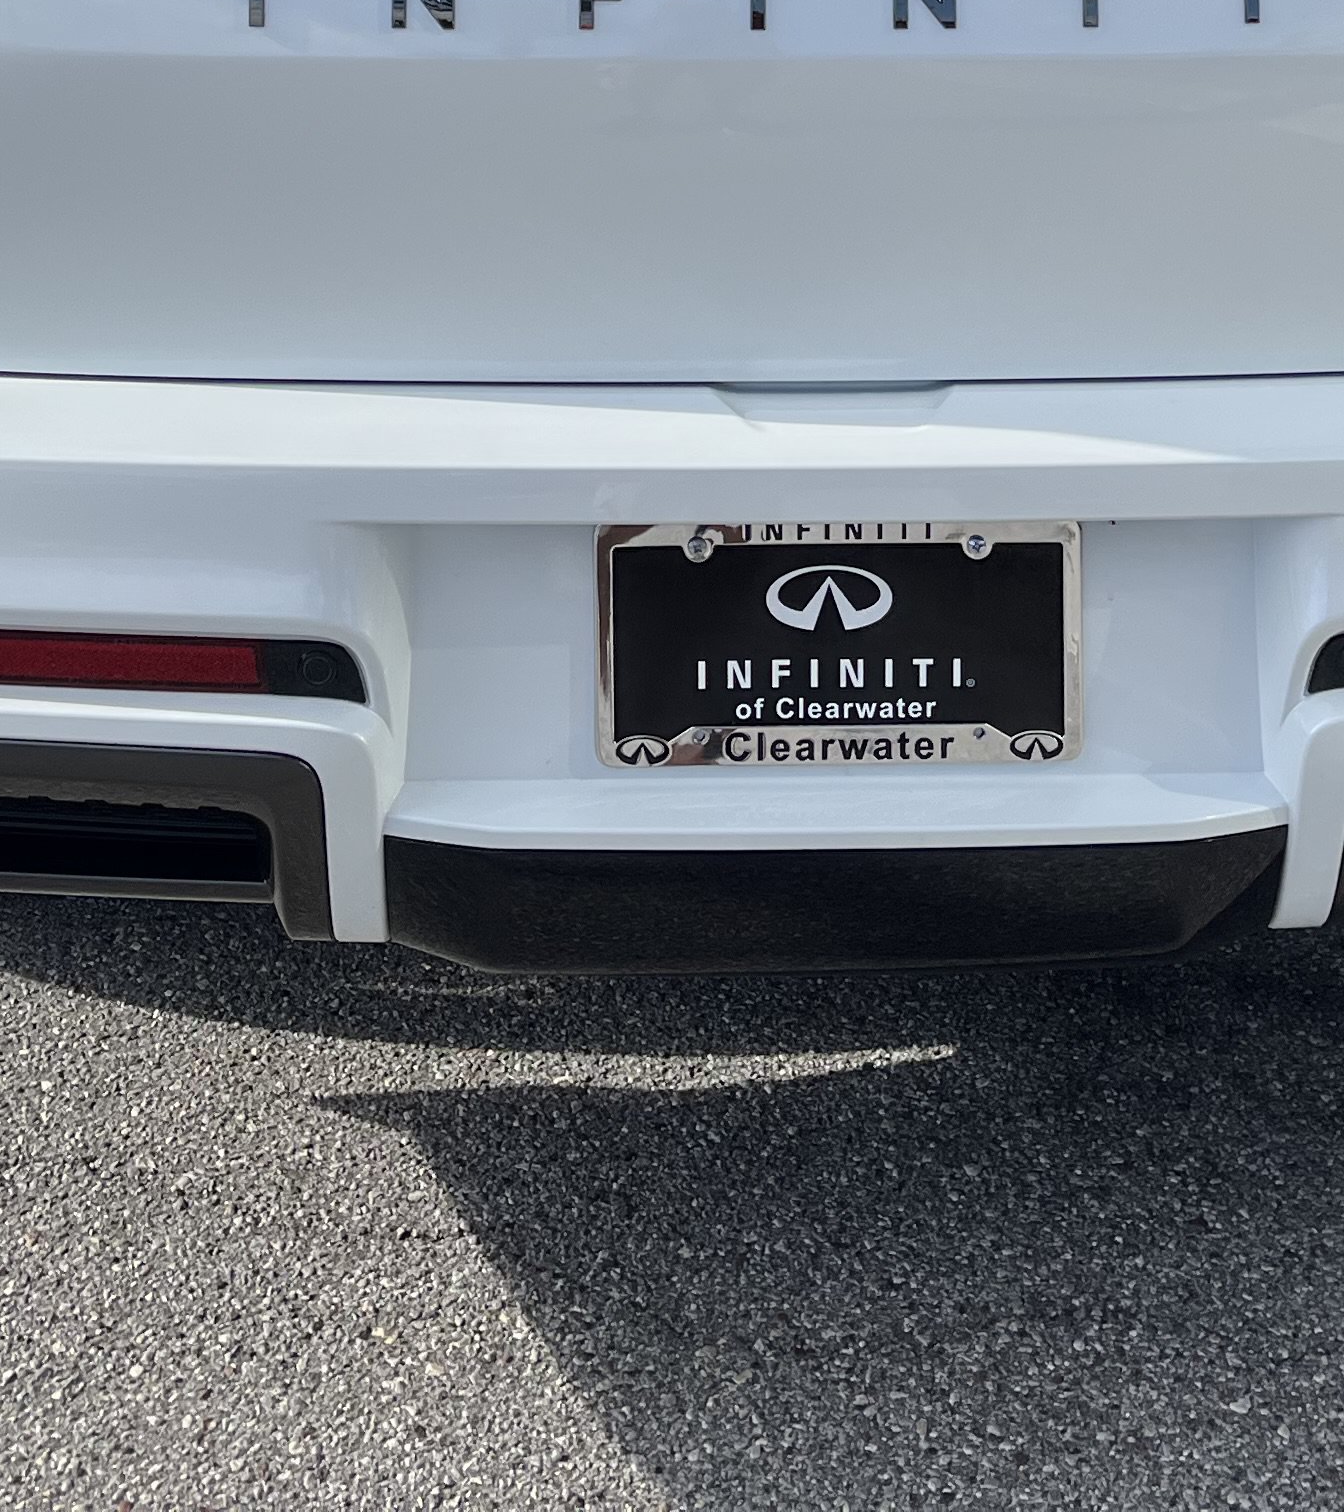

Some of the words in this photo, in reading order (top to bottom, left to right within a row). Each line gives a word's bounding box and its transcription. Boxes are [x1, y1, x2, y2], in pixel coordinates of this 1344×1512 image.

[697, 658, 962, 690] INFINITI
[736, 698, 764, 720] of
[775, 697, 937, 720] Clearwater
[724, 730, 955, 762] Clearwater
